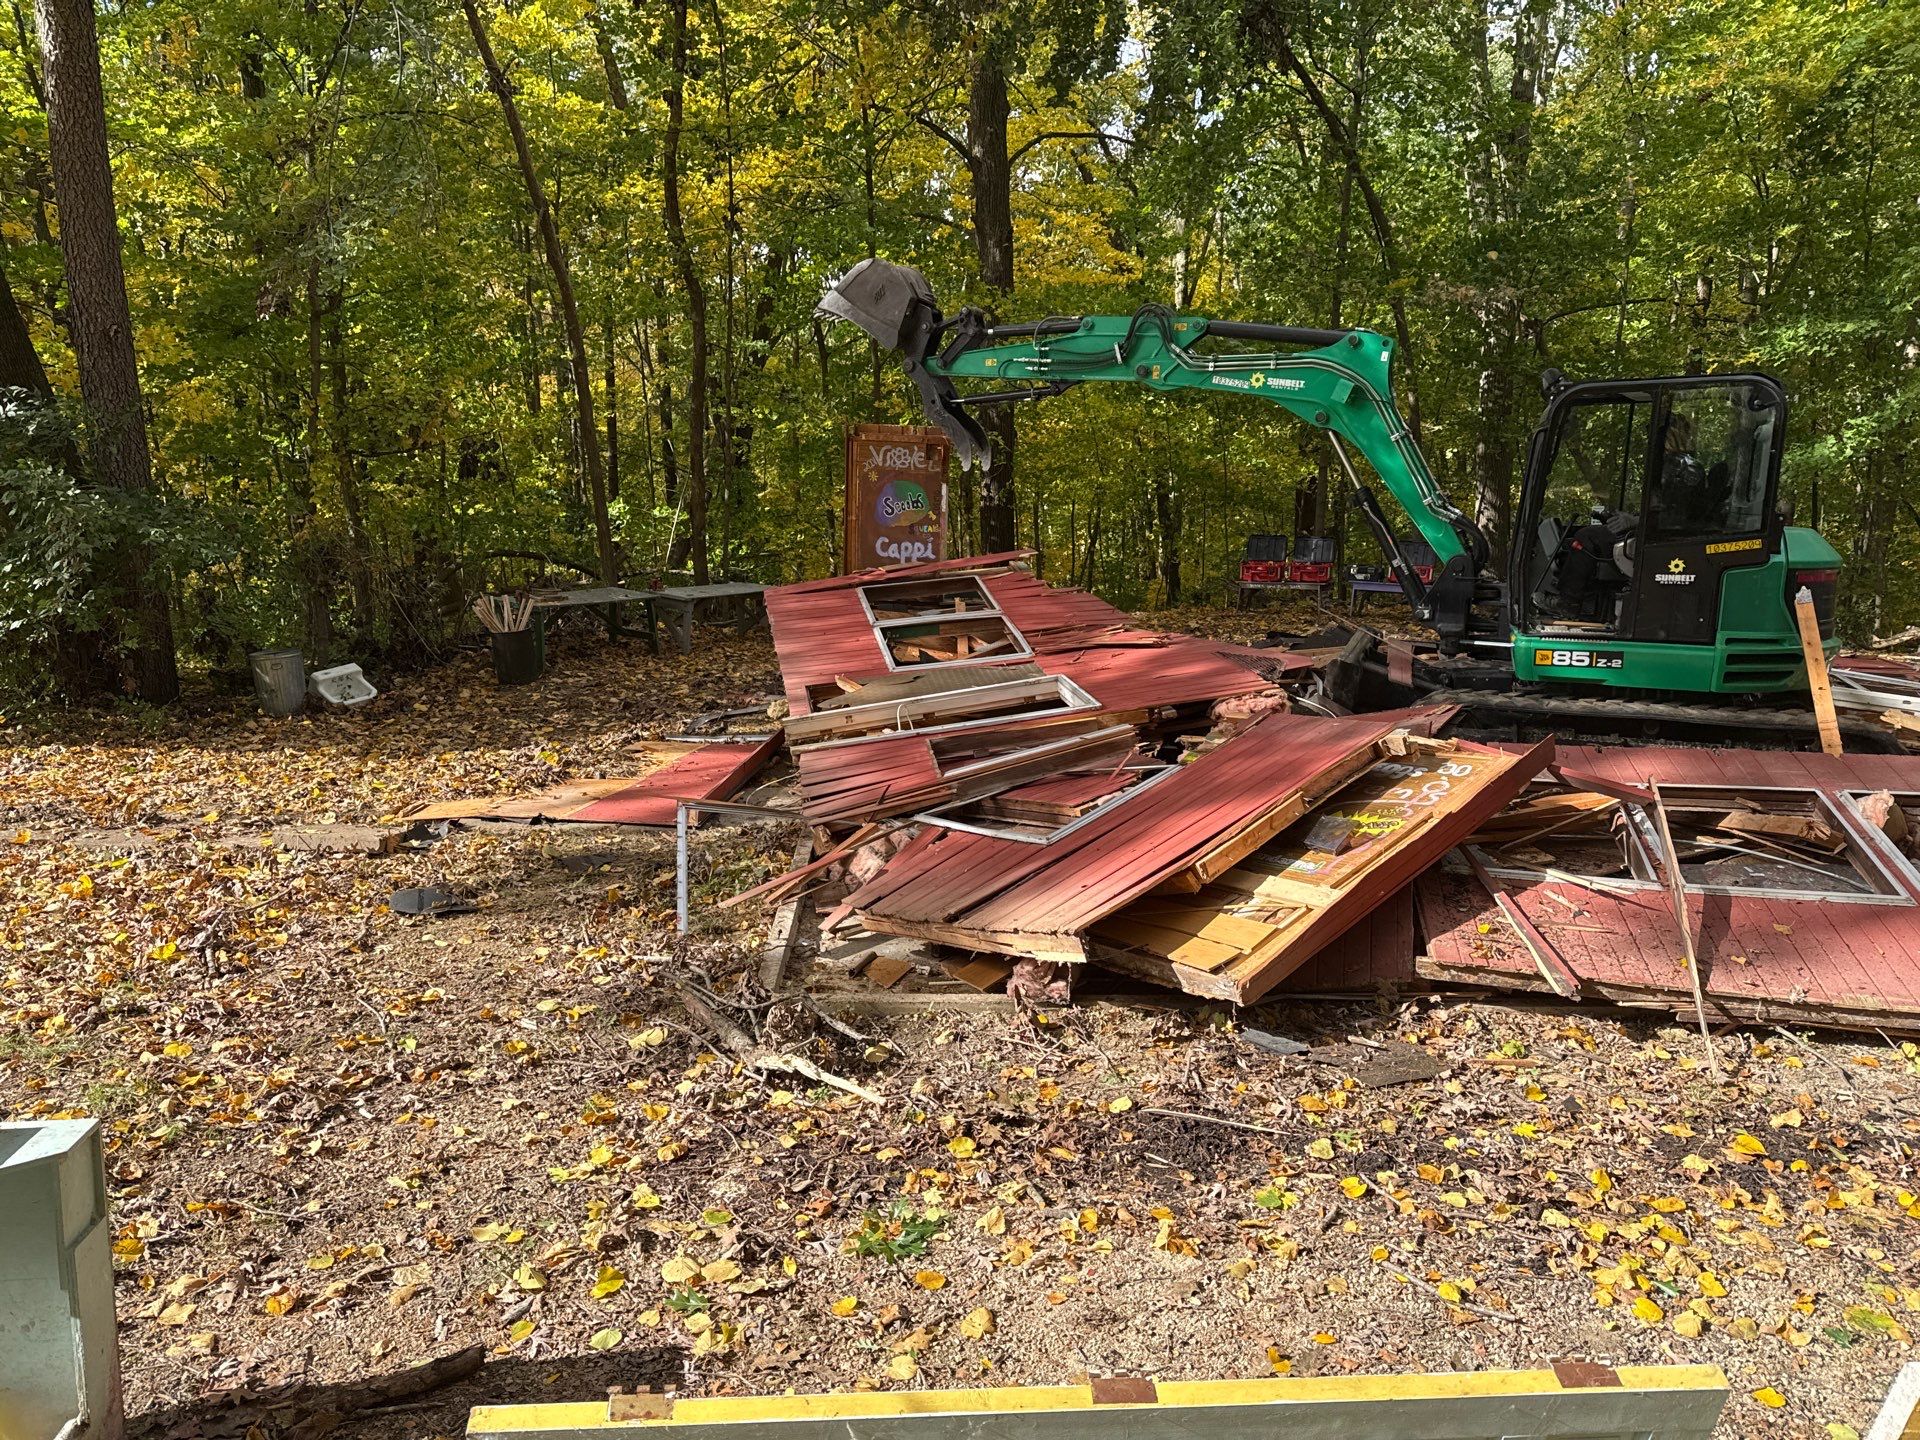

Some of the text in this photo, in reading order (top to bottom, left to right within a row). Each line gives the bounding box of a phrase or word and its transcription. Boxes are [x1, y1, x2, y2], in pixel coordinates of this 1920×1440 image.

[1267, 377, 1305, 388] SUNBELT
[875, 536, 936, 564] Cappi
[1708, 539, 1761, 554] 10375209
[1655, 574, 1696, 582] SUNBELT
[1552, 650, 1590, 666] 85
[1596, 658, 1622, 668] Z-2
